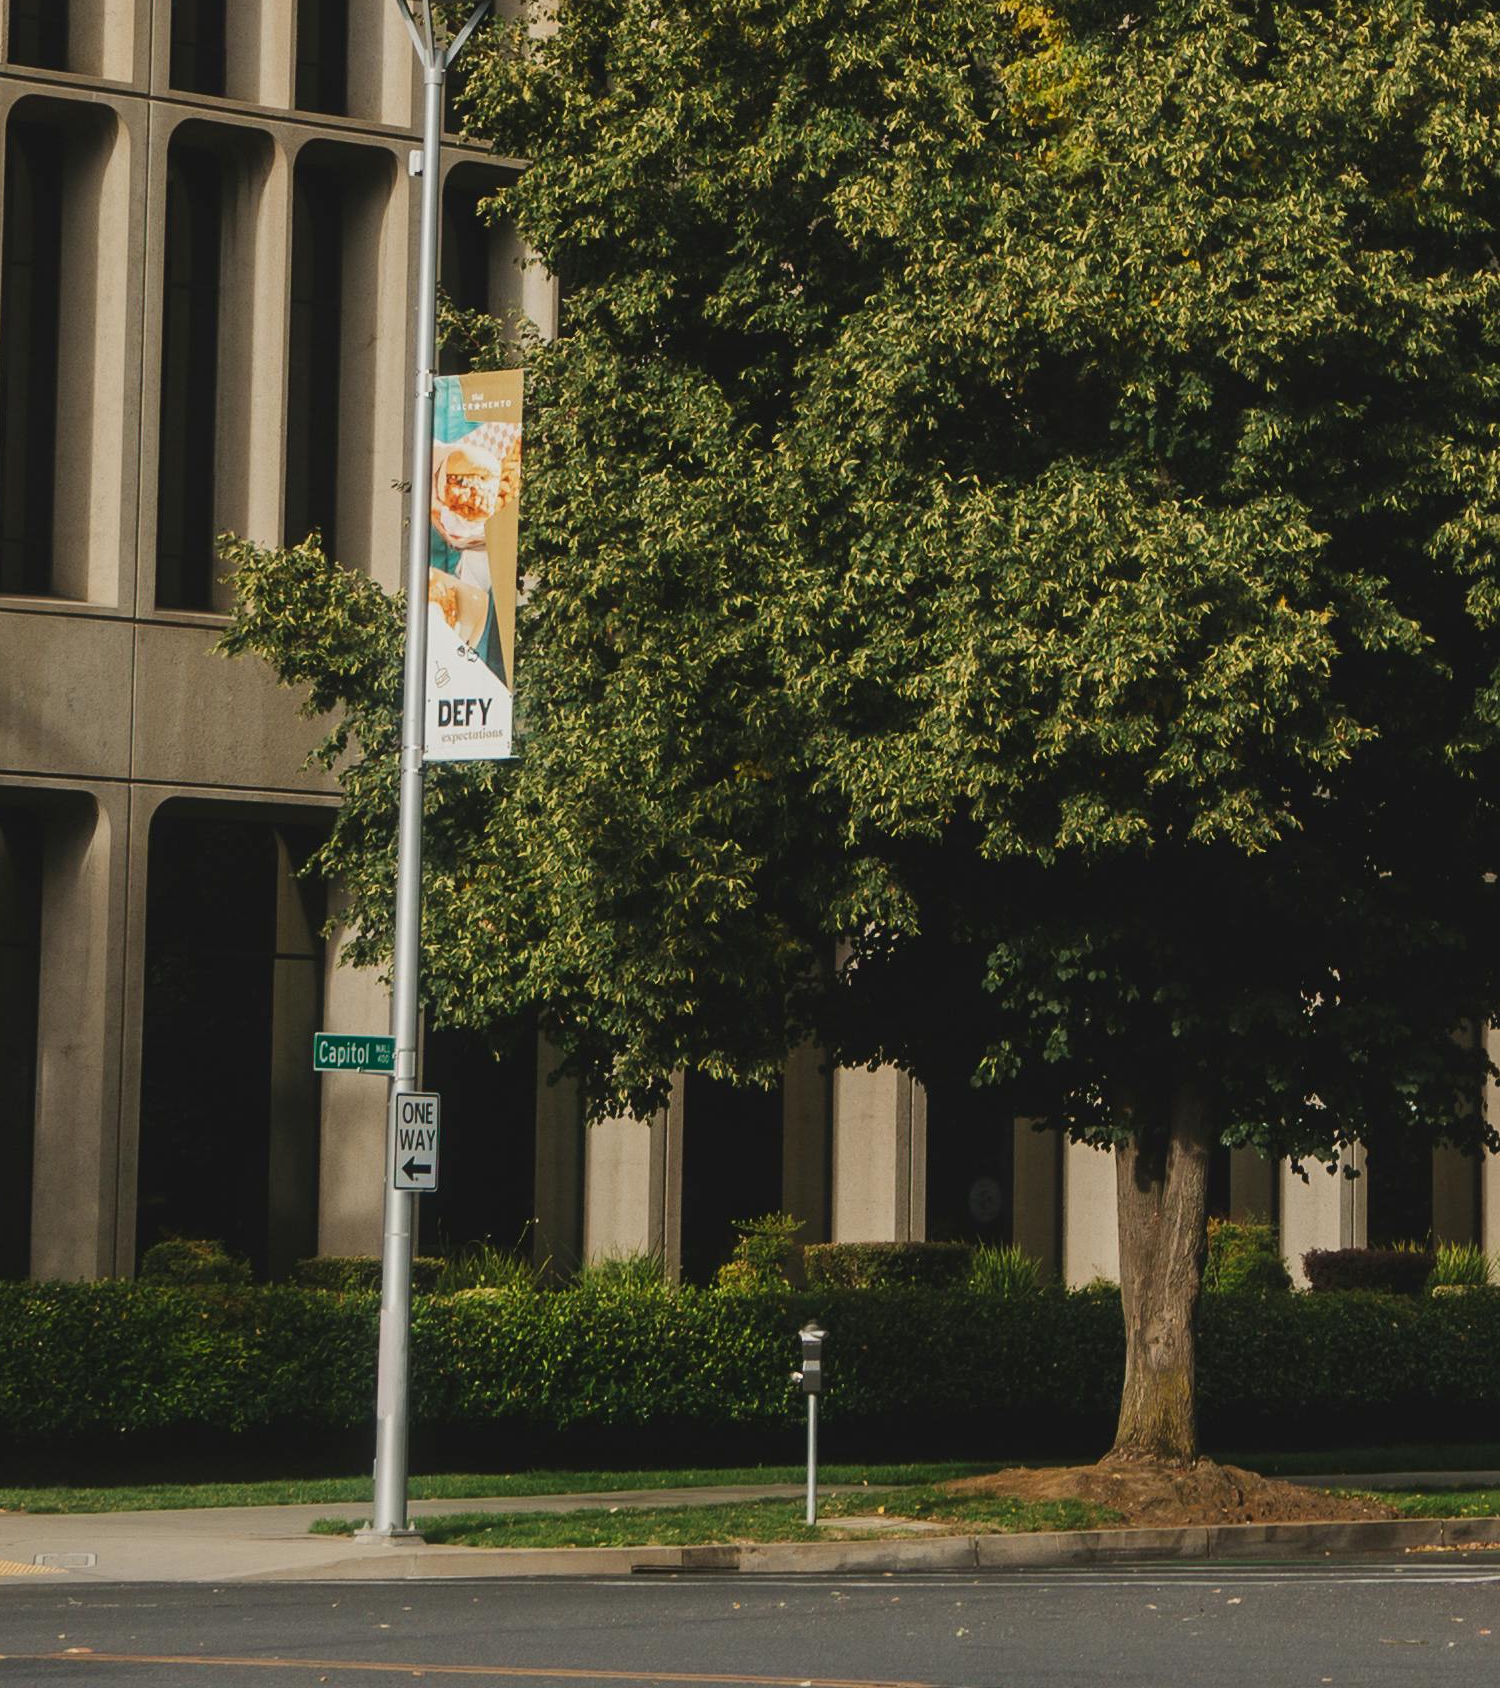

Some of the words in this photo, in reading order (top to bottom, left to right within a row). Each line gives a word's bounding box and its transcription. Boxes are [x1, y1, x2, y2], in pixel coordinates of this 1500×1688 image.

[438, 697, 493, 728] DEFY
[441, 728, 504, 744] expectations
[318, 1040, 370, 1067] Capitol
[375, 1044, 391, 1054] MALL
[402, 1102, 434, 1125] ONE
[399, 1129, 436, 1151] WAY
